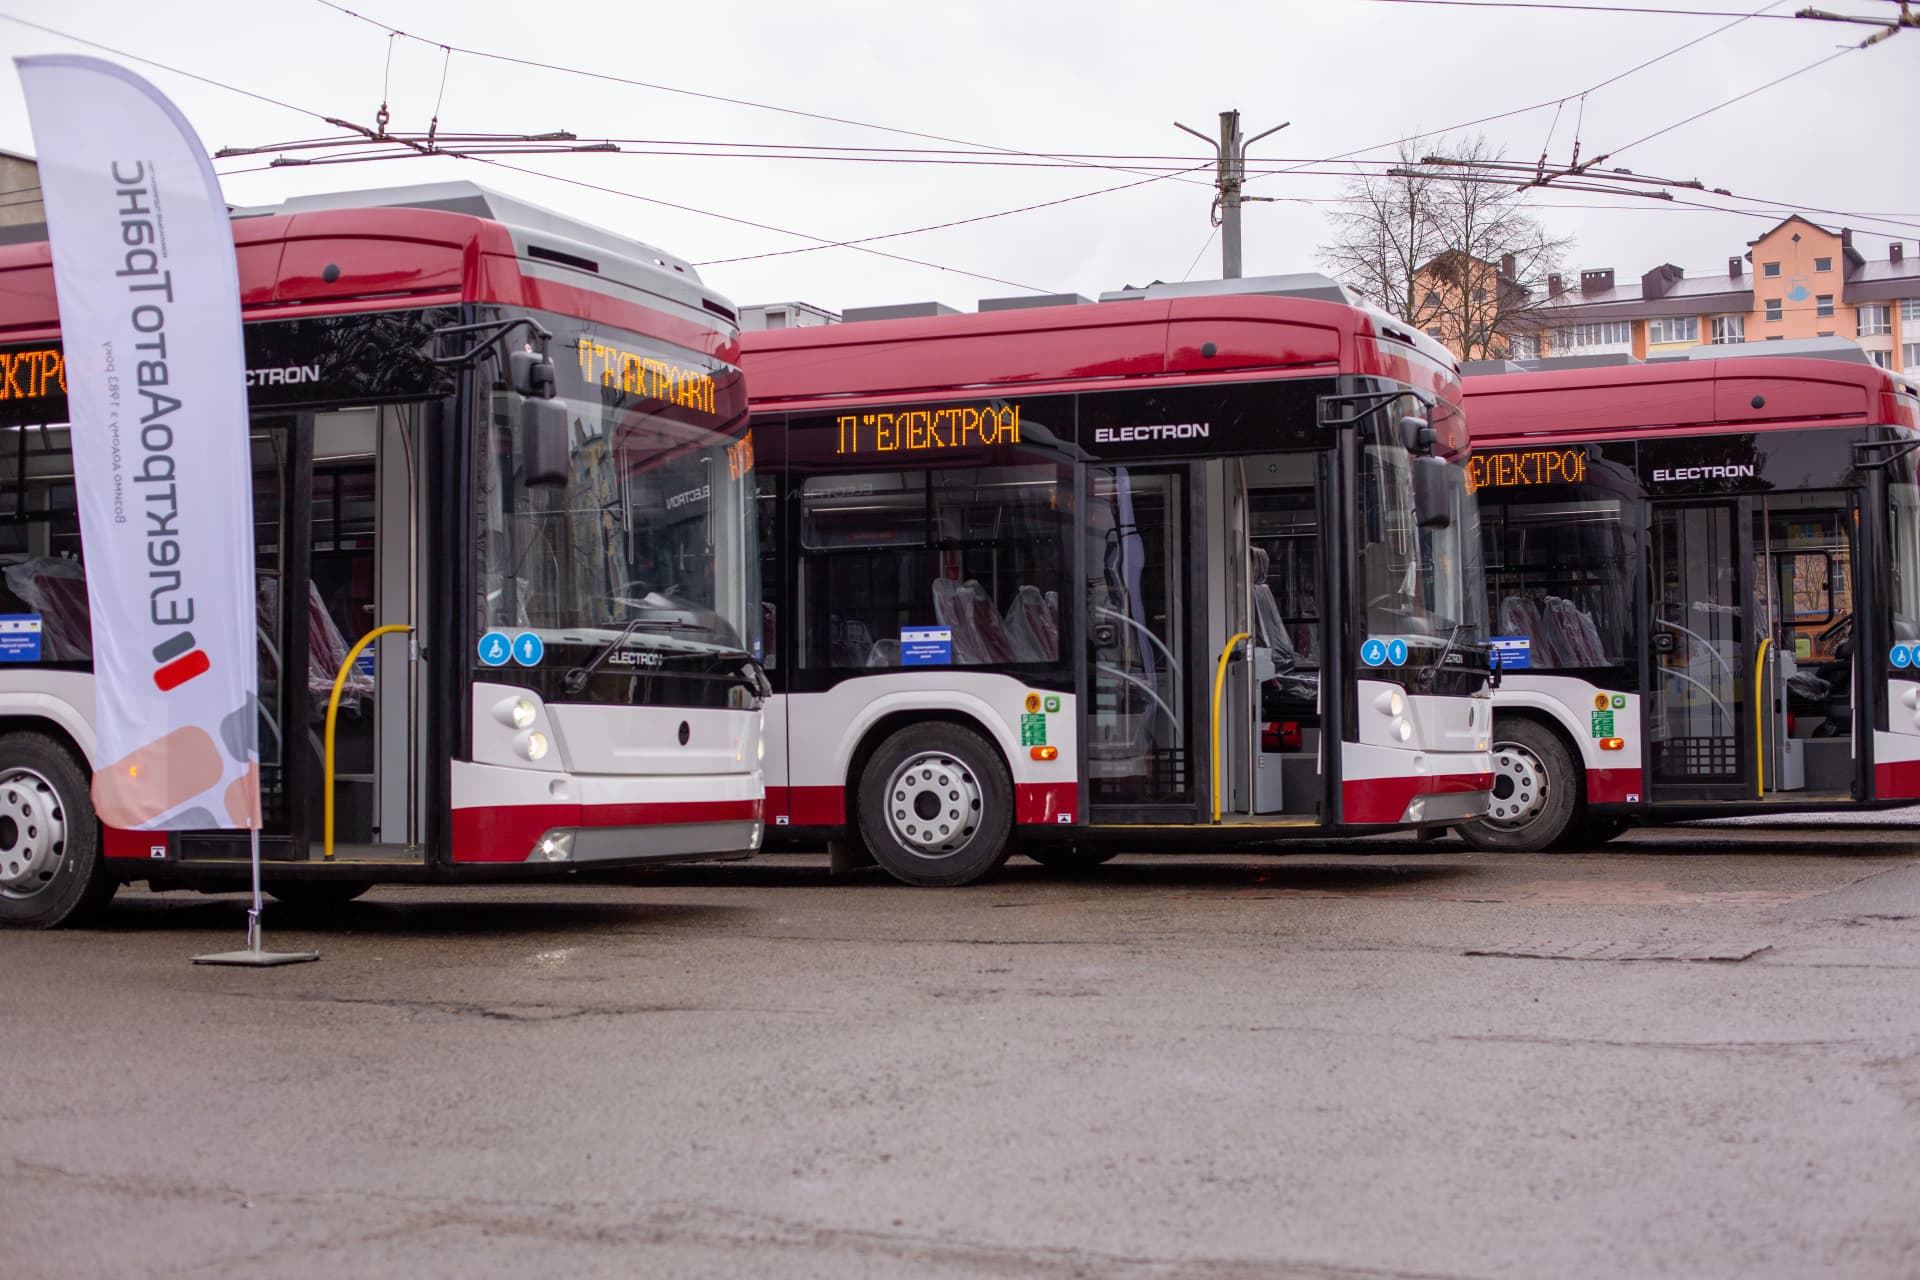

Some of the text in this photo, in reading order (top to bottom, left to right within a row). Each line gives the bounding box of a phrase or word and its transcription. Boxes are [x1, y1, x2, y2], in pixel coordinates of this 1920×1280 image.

[837, 406, 1020, 453] П "ЕЛЕКТРОА
[1095, 423, 1209, 442] ELECTRON
[1653, 465, 1754, 481] ELECTRON
